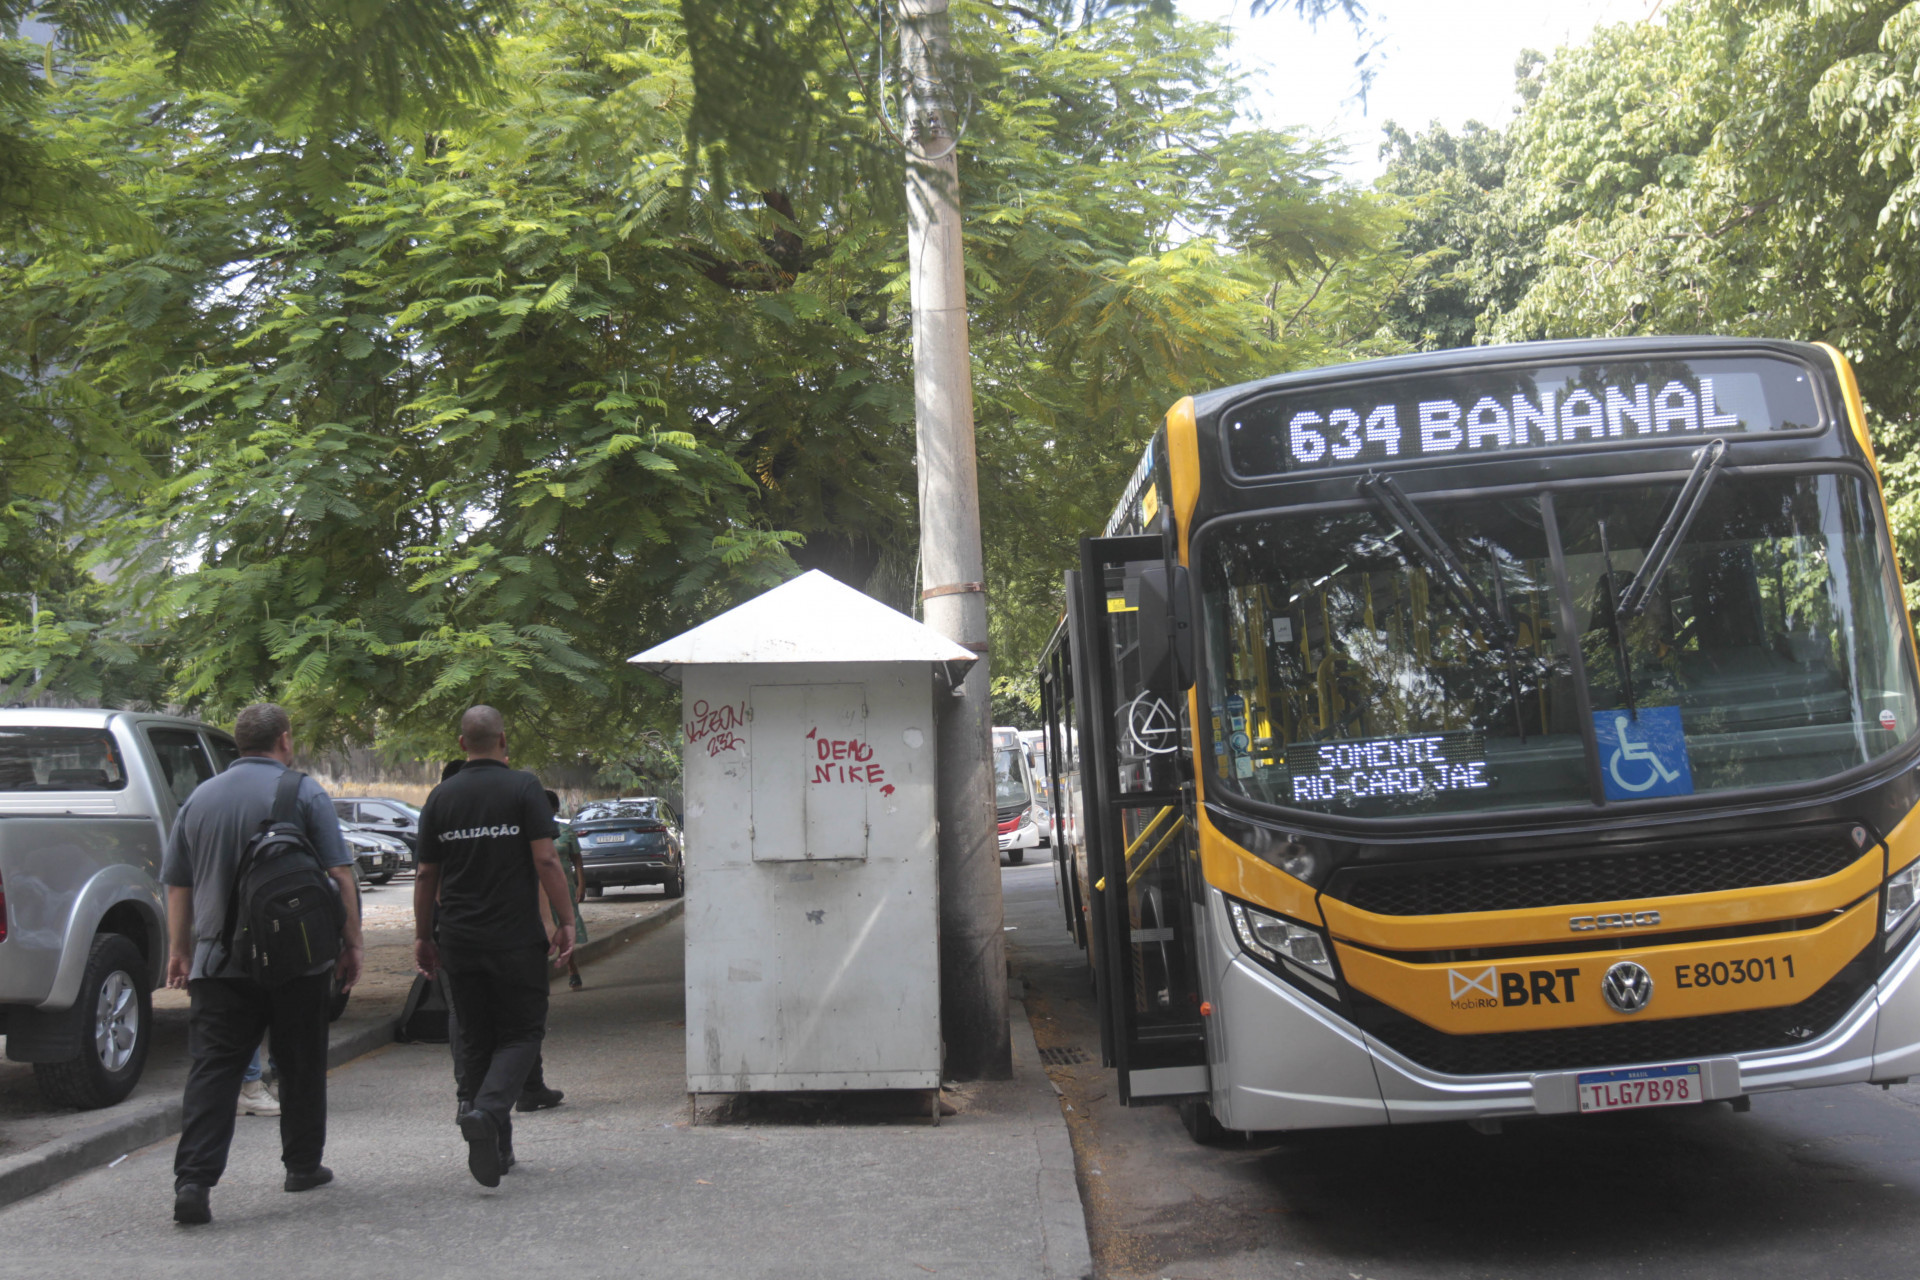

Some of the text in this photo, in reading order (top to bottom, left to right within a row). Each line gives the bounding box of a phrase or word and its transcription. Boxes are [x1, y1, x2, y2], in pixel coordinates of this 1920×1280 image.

[1289, 378, 1738, 463] 634 BANANAL
[1318, 736, 1446, 771] SOMENTE
[1293, 761, 1488, 801] RIO-CARD JAE
[1569, 910, 1661, 932] CAIO
[1500, 967, 1581, 1007] BRT
[1674, 954, 1795, 989] E803011
[1450, 998, 1498, 1010] MobiRIO
[1591, 1078, 1689, 1107] TLG7B98
[1628, 1071, 1649, 1079] BRASIL
